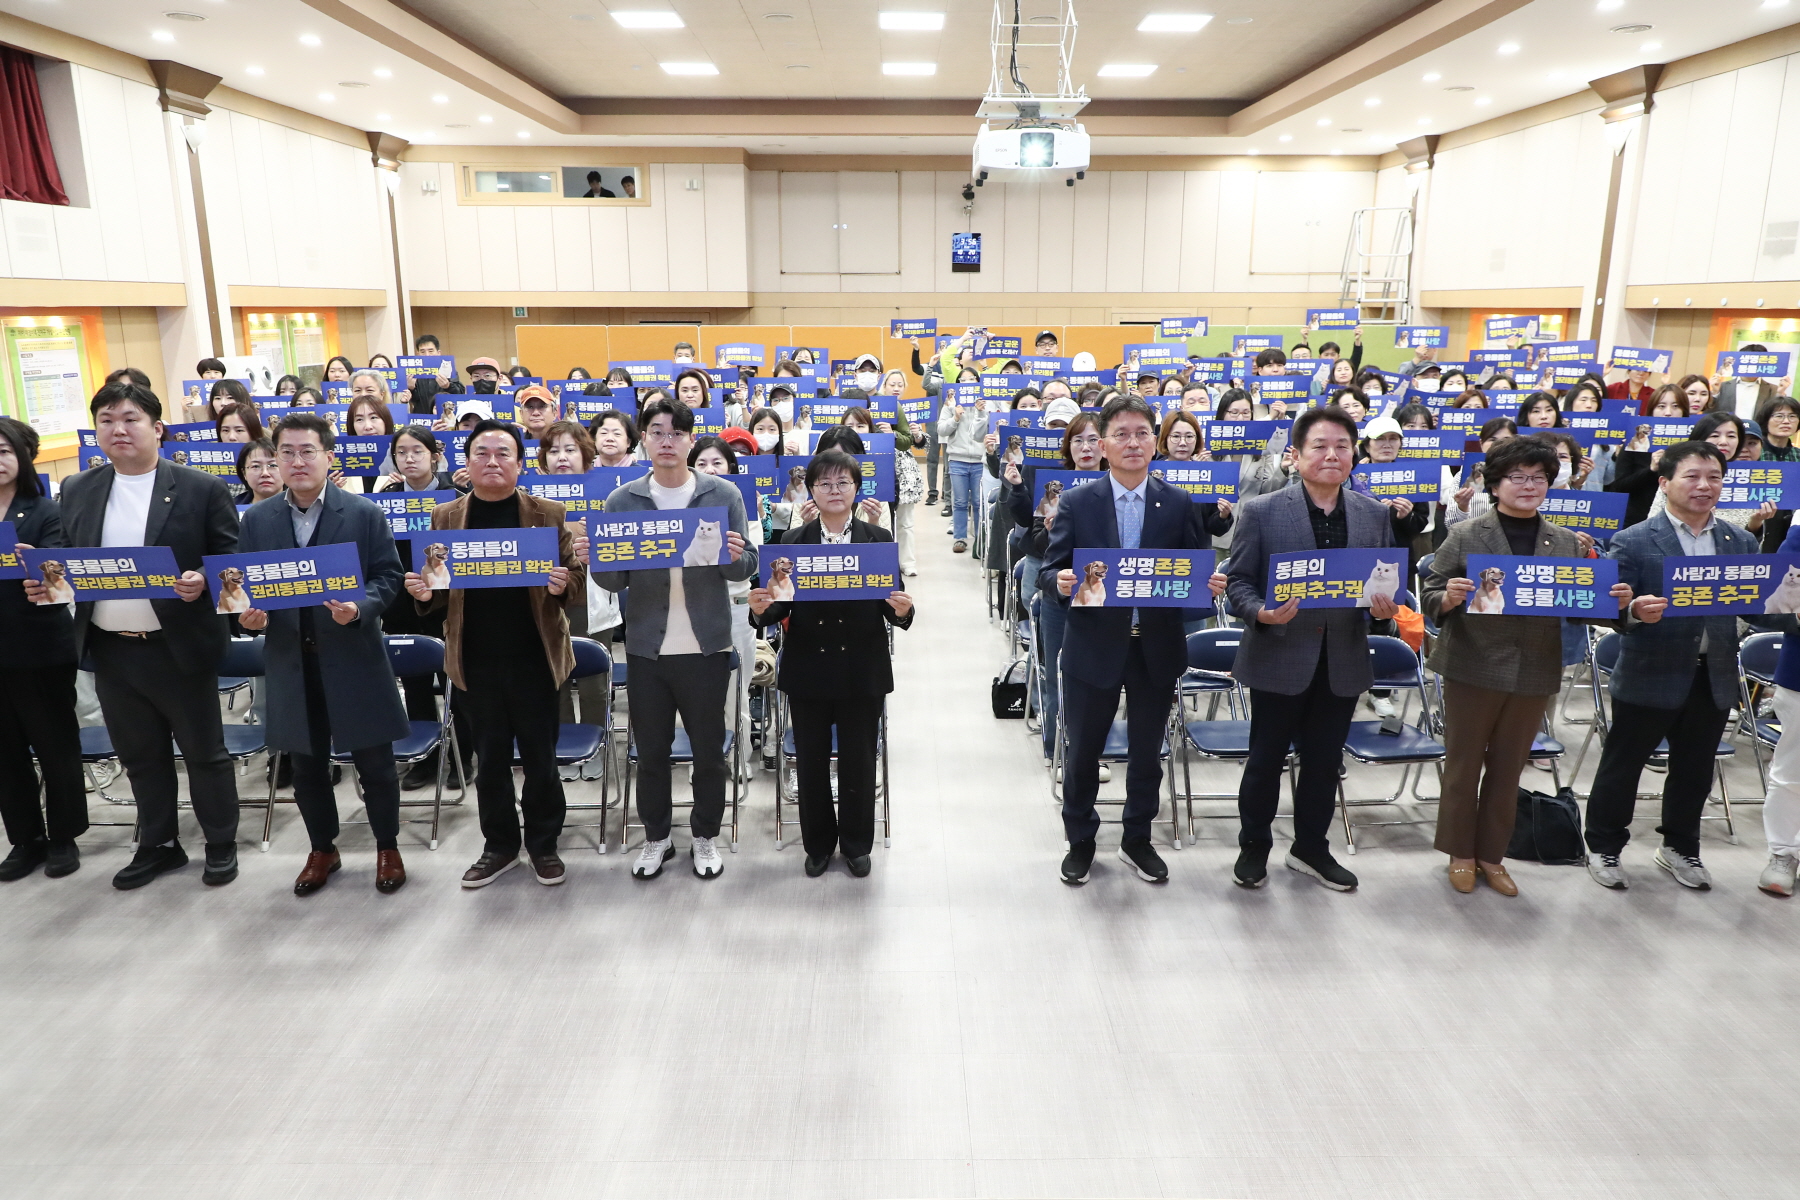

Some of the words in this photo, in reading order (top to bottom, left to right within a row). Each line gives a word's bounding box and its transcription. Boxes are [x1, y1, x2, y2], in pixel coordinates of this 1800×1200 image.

[1739, 355, 1778, 365] 생명존중
[1737, 365, 1778, 374] 동물사랑
[983, 377, 1008, 387] 동물의
[1262, 381, 1294, 391] 동물들의
[578, 402, 613, 412] 동물들의
[1427, 397, 1455, 406] 생명존
[813, 404, 848, 415] 동물들의
[881, 411, 895, 419] 확보
[496, 412, 512, 421] 확보
[814, 415, 842, 425] 권리동물
[1442, 413, 1475, 423] 동물의
[1571, 418, 1609, 428] 동물들의
[707, 425, 723, 433] 확보
[1210, 425, 1246, 437] 동물의
[1609, 430, 1626, 438] 확보
[346, 443, 378, 454] 동물의
[1209, 439, 1267, 451] 행복추구권
[1401, 437, 1440, 448] 동물들의
[189, 450, 235, 463] 동물들의
[1025, 448, 1066, 460] 권리동물
[1442, 449, 1461, 458] 확보
[345, 456, 375, 470] 추구
[1166, 469, 1211, 482] 동물들의
[1370, 470, 1415, 483] 동물들의
[531, 484, 584, 498] 동물들의
[1215, 484, 1235, 495] 확보
[1370, 483, 1417, 496] 권리동물권
[1418, 483, 1438, 493] 확보
[595, 521, 639, 539] 사람과
[641, 519, 684, 536] 동물의
[1593, 516, 1619, 532] 확보
[451, 540, 518, 559] 동물들의
[596, 542, 635, 563] 공존
[639, 538, 678, 560] 추구
[65, 557, 138, 575] 동물들의
[245, 559, 317, 582] 동물들의
[452, 560, 523, 577] 권리동물권
[525, 559, 553, 574] 확보
[796, 555, 859, 573] 동물들의
[1117, 557, 1192, 577] 생명존중
[1275, 558, 1325, 580] 동물의
[1515, 564, 1595, 586] 생명존중
[1672, 566, 1721, 582] 사람과
[1724, 564, 1771, 580] 동물의
[72, 574, 147, 590] 권리동물권
[147, 573, 177, 588] 확보
[250, 579, 324, 599] 권리동물권
[325, 574, 359, 592] 확보
[797, 574, 863, 589] 권리동물권
[866, 574, 894, 588] 확보
[1116, 580, 1192, 599] 동물사랑
[1274, 580, 1363, 602] 행복추구권
[1672, 586, 1714, 607] 공존
[1717, 584, 1760, 605] 추구
[1514, 587, 1596, 609] 동물사랑
